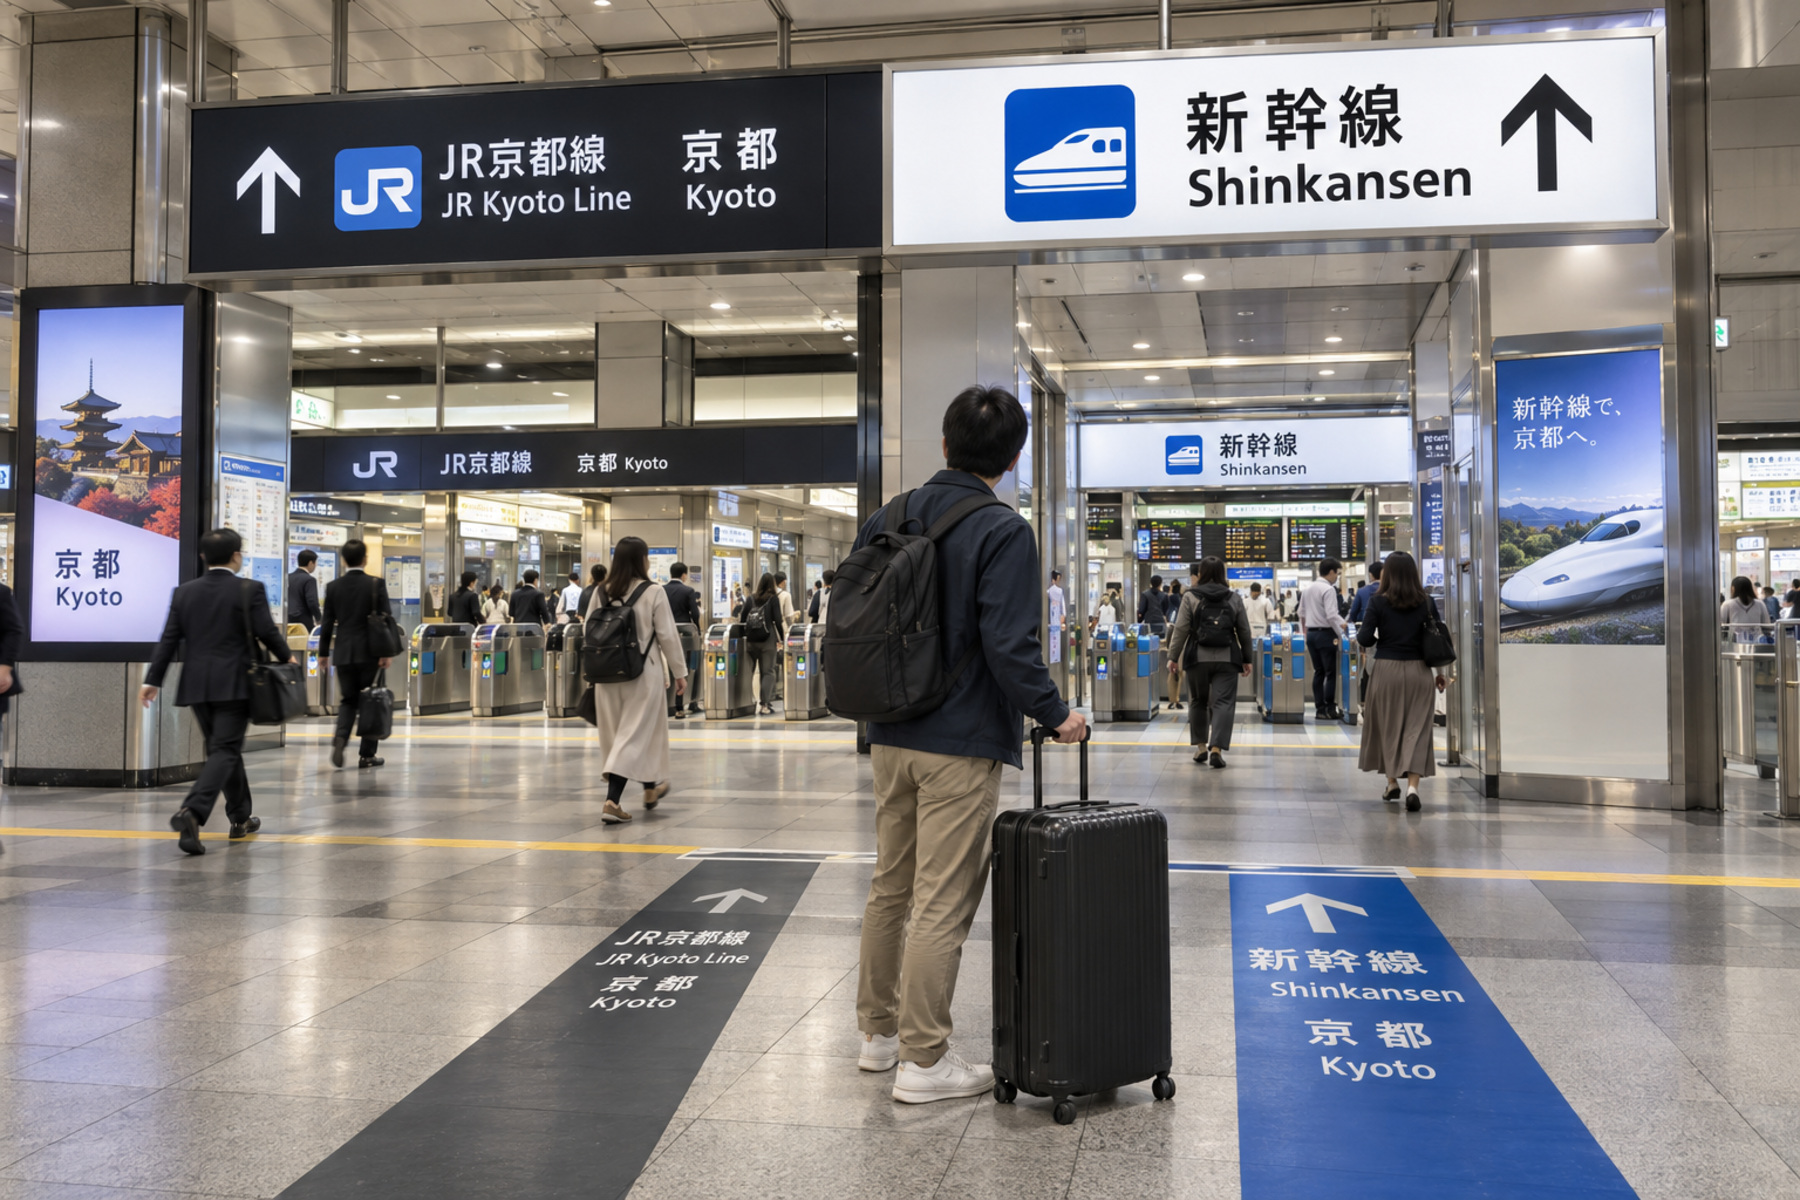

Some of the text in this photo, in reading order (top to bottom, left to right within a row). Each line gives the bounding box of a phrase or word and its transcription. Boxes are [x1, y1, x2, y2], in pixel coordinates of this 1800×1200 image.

[1187, 84, 1402, 154] 新幹線
[439, 135, 605, 181] JR京都線
[342, 168, 413, 215] JR
[1189, 164, 1470, 207] Shinkansen
[442, 186, 631, 221] JR Kyoto Line
[688, 184, 776, 215] Kyoto
[1514, 394, 1620, 420] 新幹線で、
[1220, 432, 1297, 458] 新幹線
[1514, 426, 1596, 449] 京都へ。
[353, 451, 397, 478] JR
[441, 450, 531, 474] JR京都線
[578, 453, 667, 473] 京都 Kyoto
[1221, 463, 1306, 476] Shinkansen
[57, 587, 122, 610] Kyoto
[615, 931, 750, 945] JR京都線
[596, 953, 749, 967] JR Kyoto Line
[1249, 948, 1427, 973] 新幹線
[590, 997, 676, 1011] Kyoto
[1271, 982, 1464, 1002] Shinkansen
[1321, 1056, 1435, 1081] Kyoto
